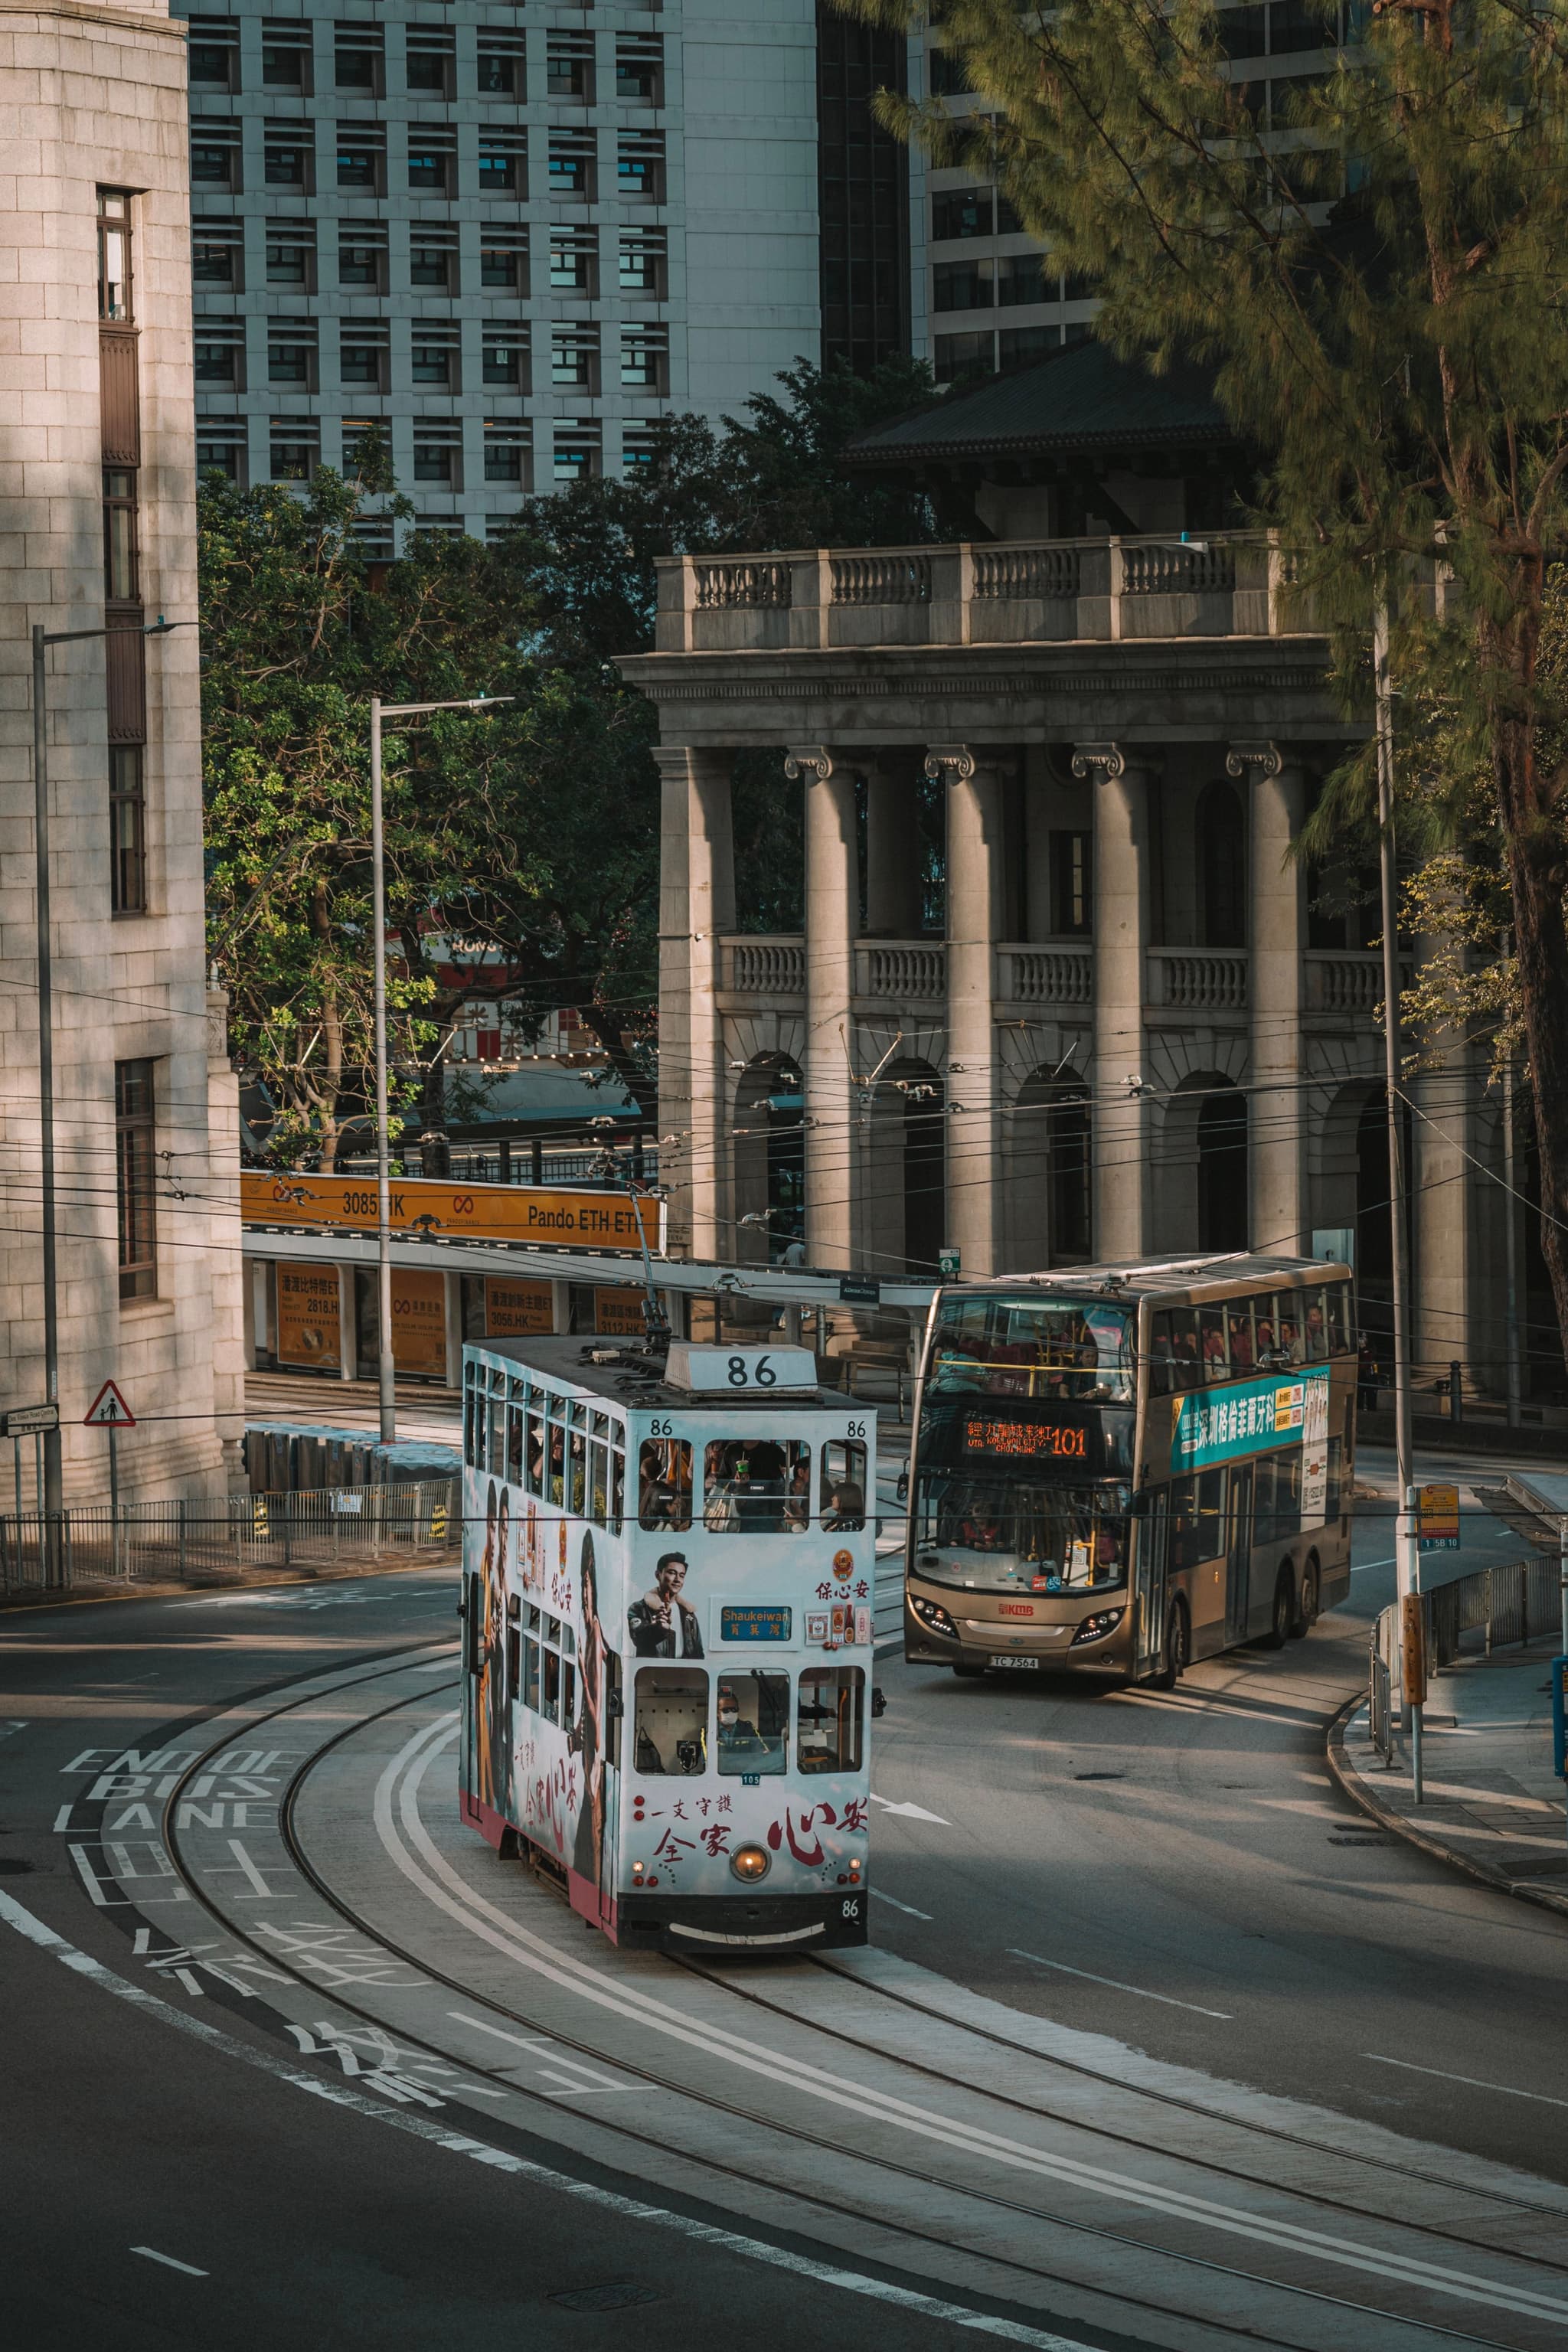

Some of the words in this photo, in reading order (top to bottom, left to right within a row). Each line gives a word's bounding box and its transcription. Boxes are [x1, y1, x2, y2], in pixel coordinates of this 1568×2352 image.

[343, 1191, 405, 1217] 3085K
[528, 1205, 574, 1230] Pando
[579, 1209, 610, 1232] ETH
[307, 1298, 339, 1315] 2818.H
[727, 1355, 777, 1387] 86
[651, 1419, 673, 1436] 86
[847, 1420, 866, 1438] 86
[996, 1444, 1014, 1452] CHOI
[1016, 1445, 1036, 1454] HUNG
[1051, 1427, 1086, 1457] 101
[1435, 1539, 1446, 1547] 5B
[1449, 1538, 1457, 1547] 10
[815, 1579, 870, 1600] 保心安
[723, 1609, 789, 1622] Shaukeiwan
[1008, 1604, 1034, 1616] KMB
[994, 1657, 1007, 1666] TC
[1010, 1657, 1035, 1668] 7564
[58, 1749, 204, 1772] END
[207, 1749, 308, 1774] OF
[86, 1775, 281, 1800] BUS
[743, 1776, 760, 1785] 105
[53, 1802, 280, 1832] LANE
[842, 1899, 858, 1917] 86
